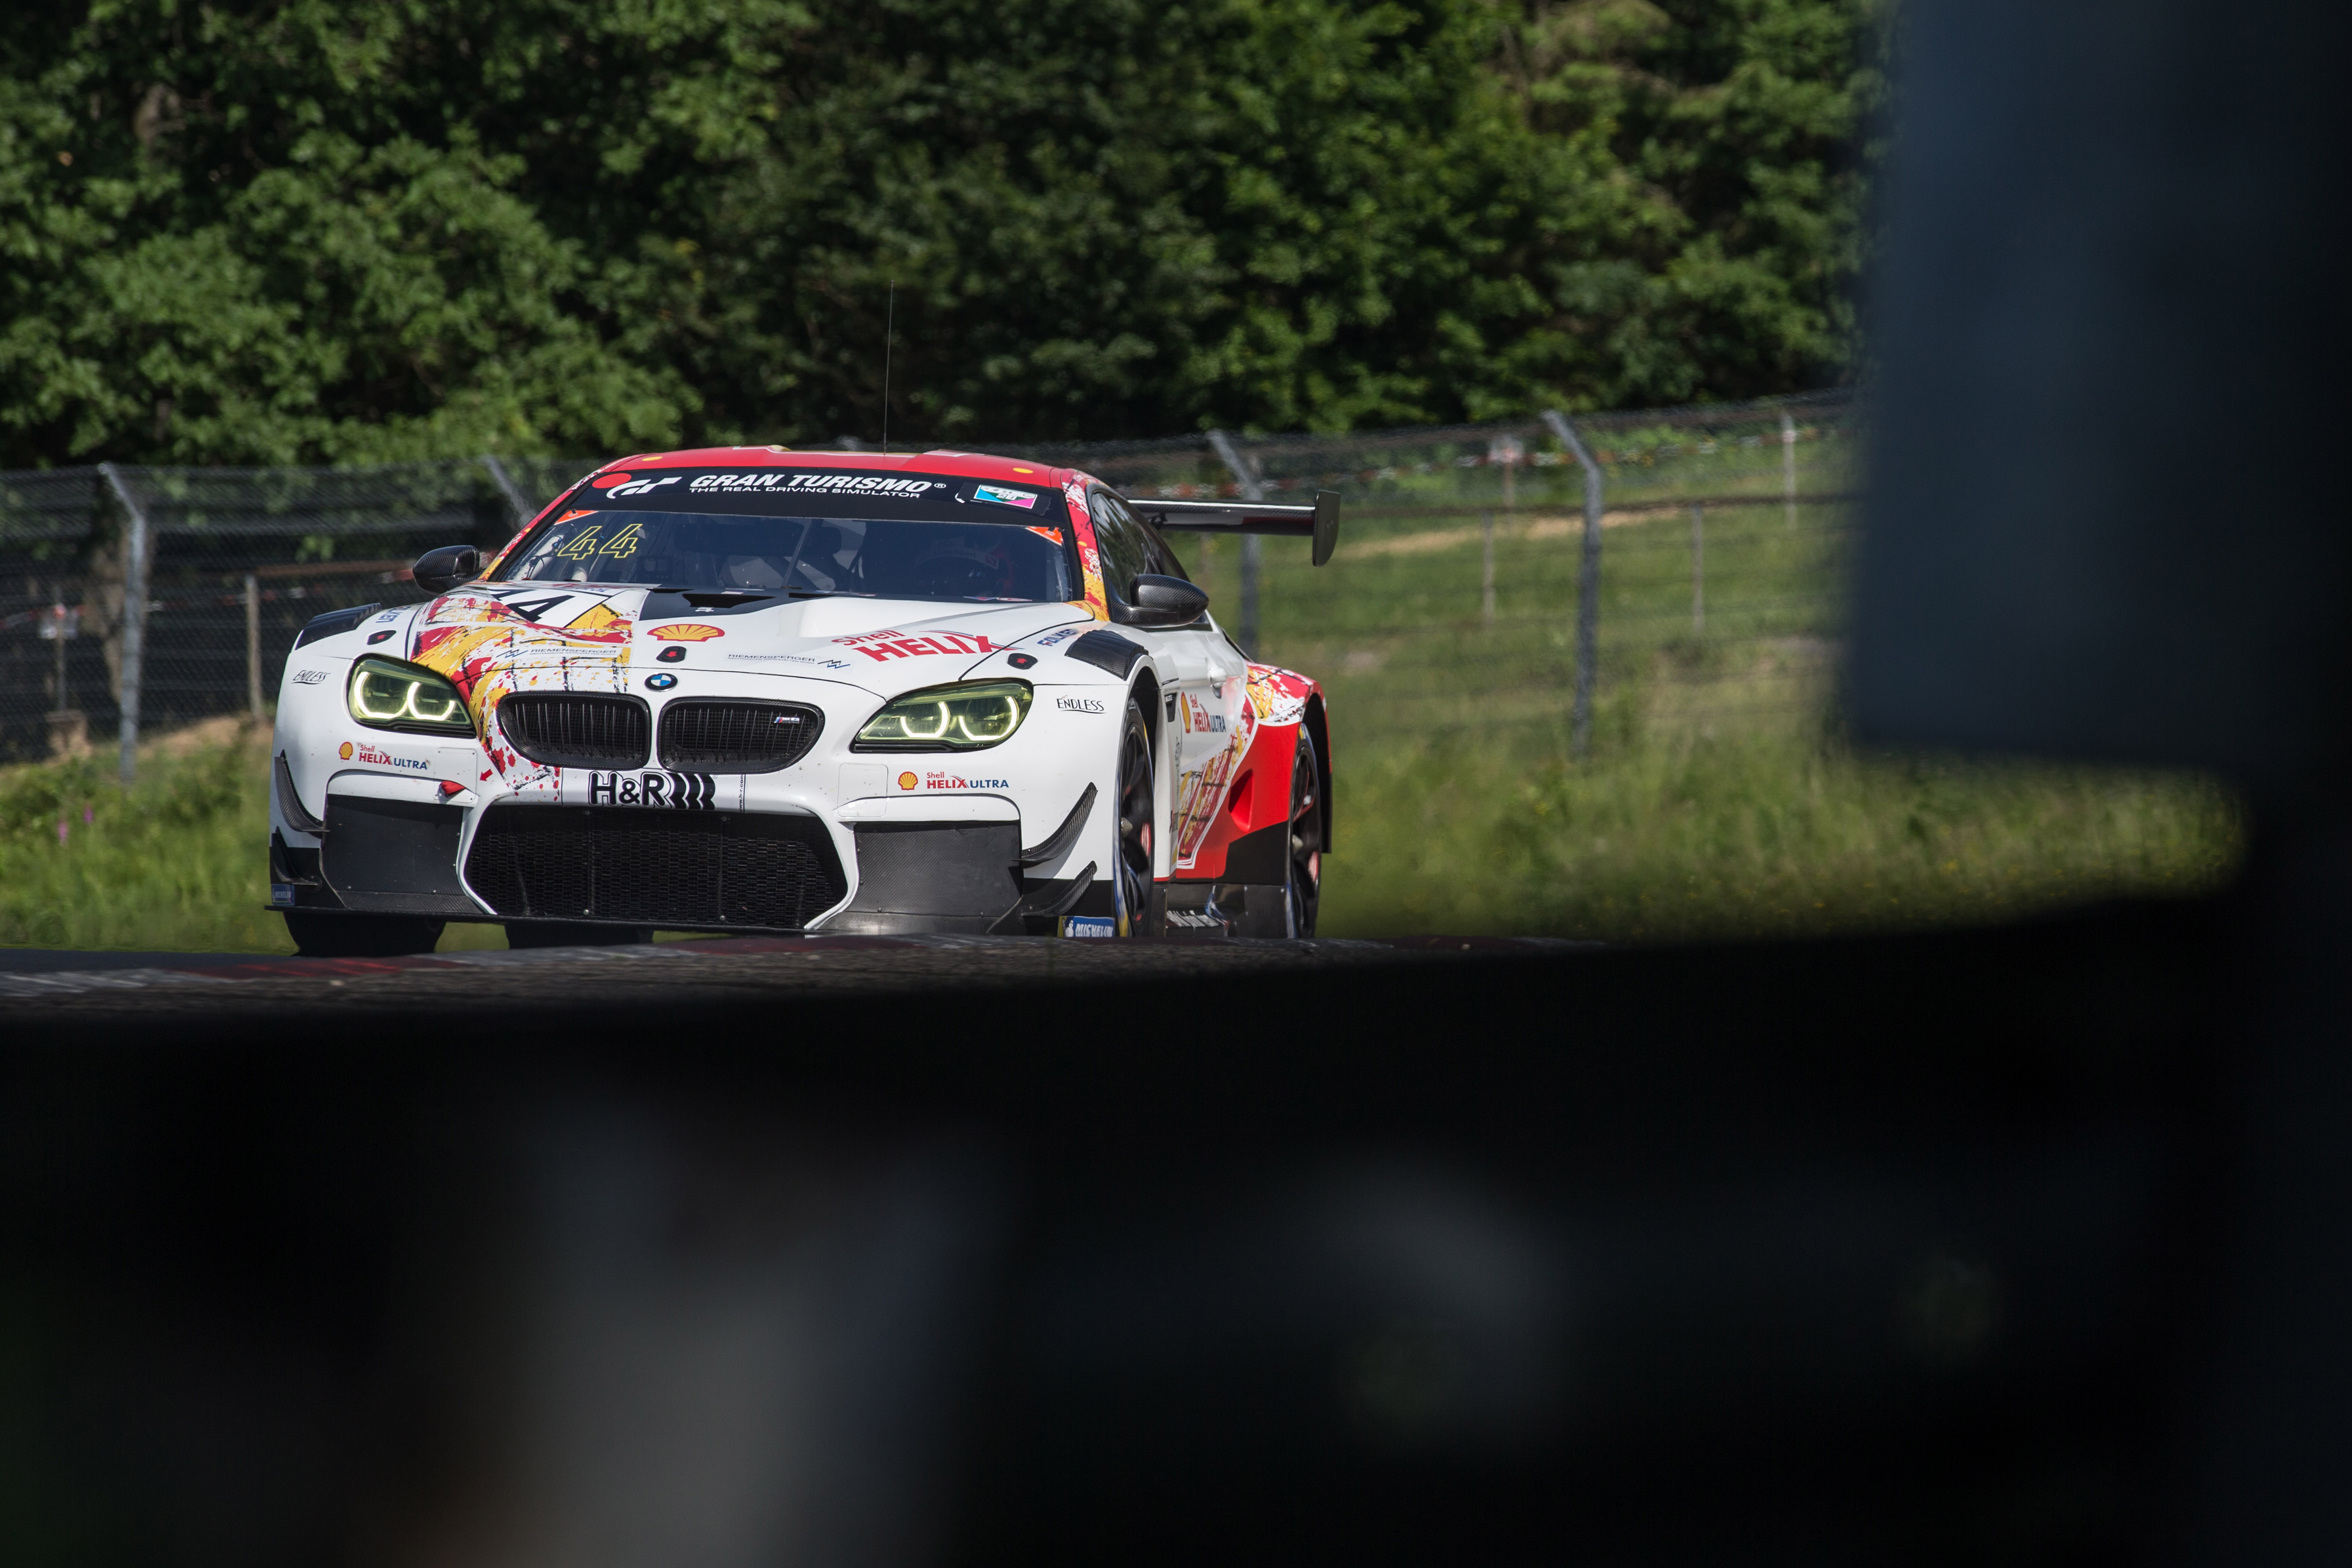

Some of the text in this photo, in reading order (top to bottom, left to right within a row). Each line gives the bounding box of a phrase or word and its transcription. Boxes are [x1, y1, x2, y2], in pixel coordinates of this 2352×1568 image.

[690, 474, 932, 492] GRAN TURISMO
[831, 488, 920, 498] SIMULATOR
[556, 523, 643, 560] 44
[831, 629, 906, 646] Shell
[851, 633, 1018, 662] HELIX
[728, 653, 815, 662] RIEMENSPERGER
[292, 670, 331, 682] ENDLESS
[1057, 698, 1104, 711] ENDLESS
[1193, 710, 1227, 732] HELIX ULTRA
[359, 744, 375, 753] Shell
[358, 751, 428, 770] HELIX ULTRA
[589, 772, 668, 806] H&R
[926, 777, 1009, 789] HELIX ULTRA
[1075, 923, 1114, 937] MICHELIN
